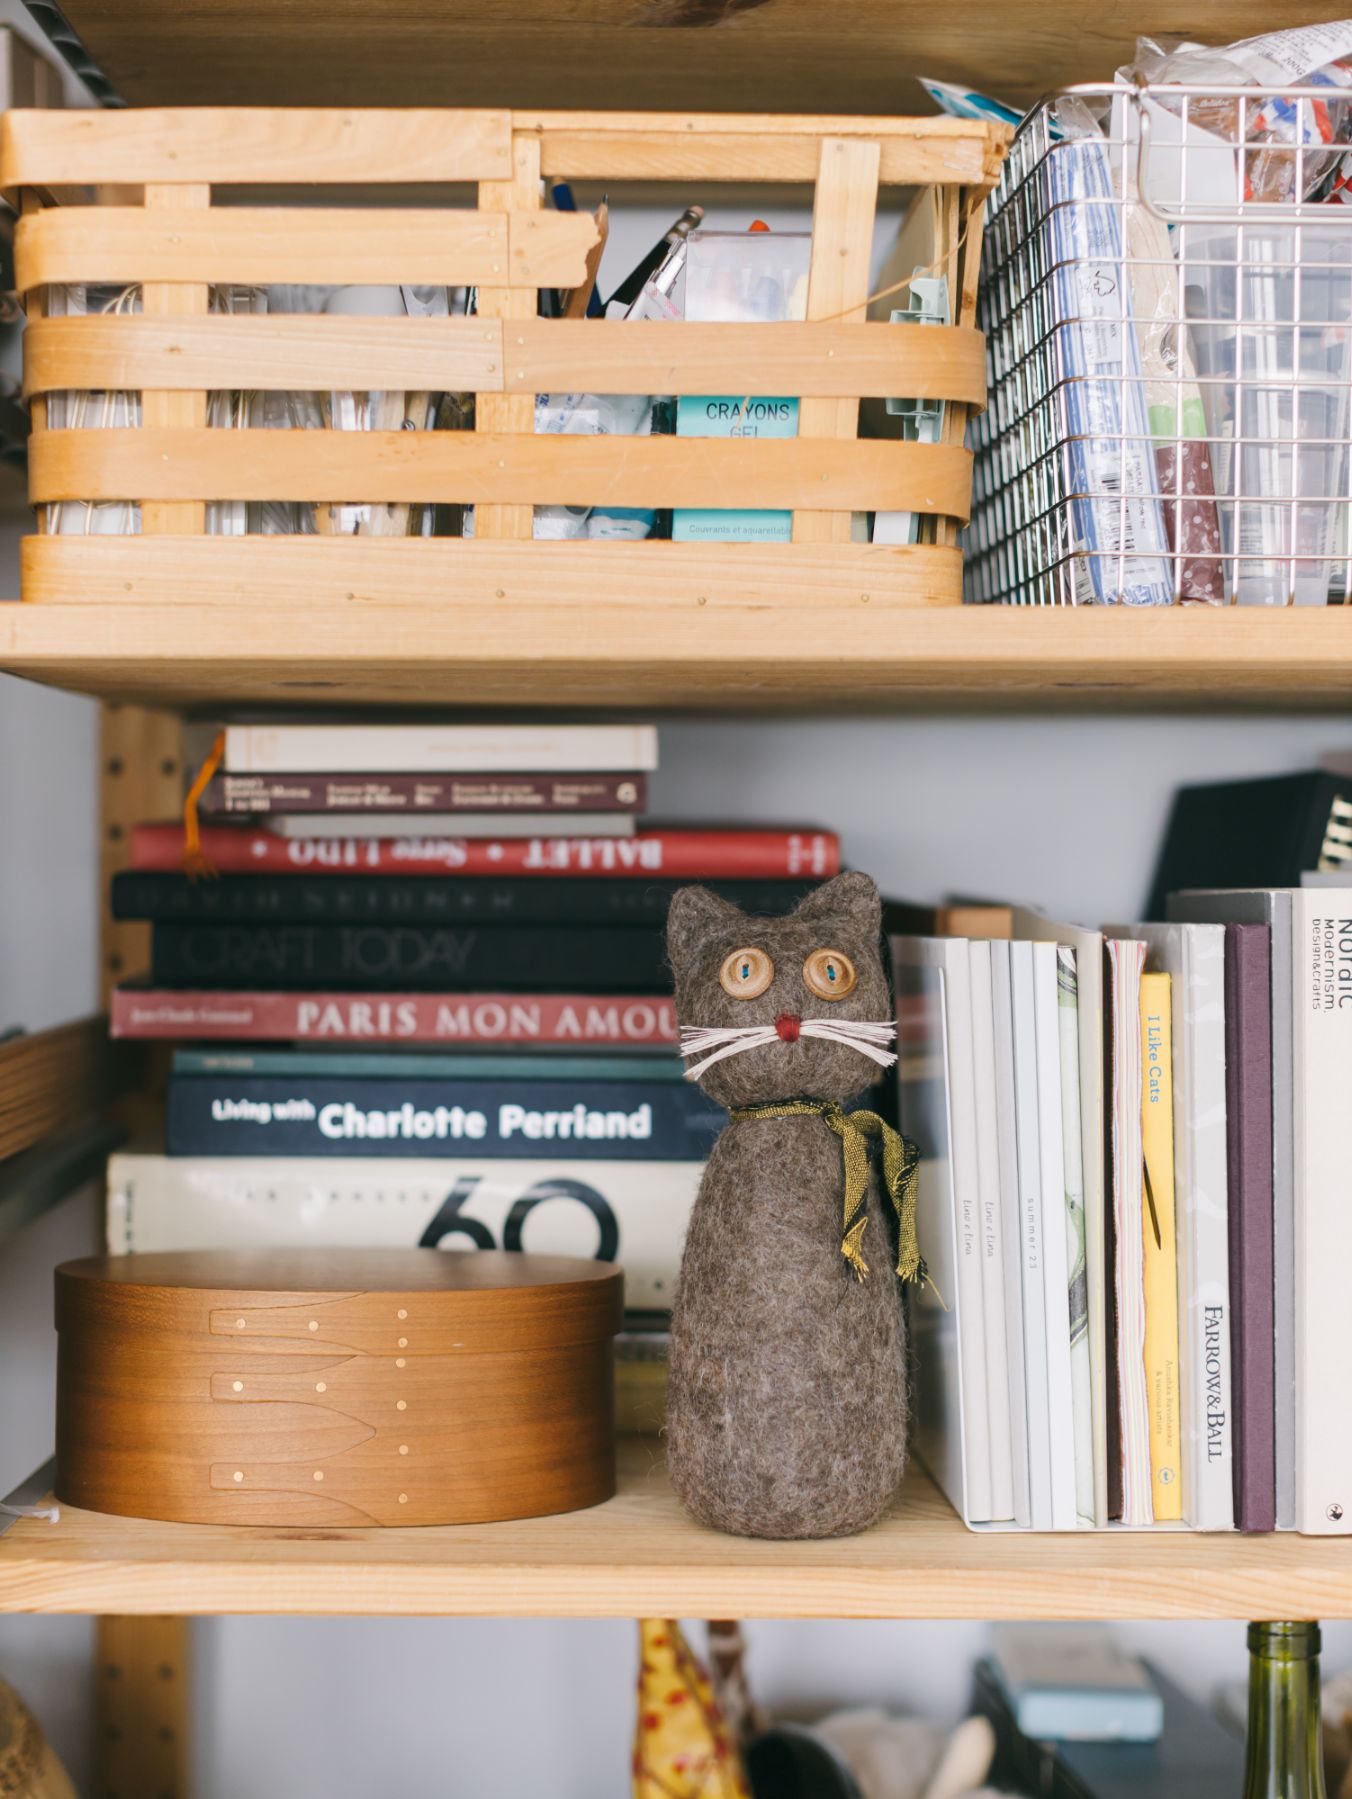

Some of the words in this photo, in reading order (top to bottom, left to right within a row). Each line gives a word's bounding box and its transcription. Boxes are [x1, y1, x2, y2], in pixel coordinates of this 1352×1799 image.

[706, 402, 790, 421] CRAYONS
[733, 524, 741, 534] et
[522, 839, 662, 869] BALLET
[182, 926, 320, 969] CRAFT
[339, 926, 478, 974] TODAY
[297, 1001, 418, 1035] PARIS
[435, 1003, 542, 1038] MON
[1148, 1027, 1162, 1061] Like
[1149, 1066, 1162, 1103] Cats
[211, 1099, 271, 1124] Living
[272, 1100, 317, 1121] with
[318, 1102, 488, 1139] Charlotte
[498, 1103, 653, 1139] Perriand
[417, 1176, 621, 1261] 60
[1027, 1198, 1036, 1249] summer
